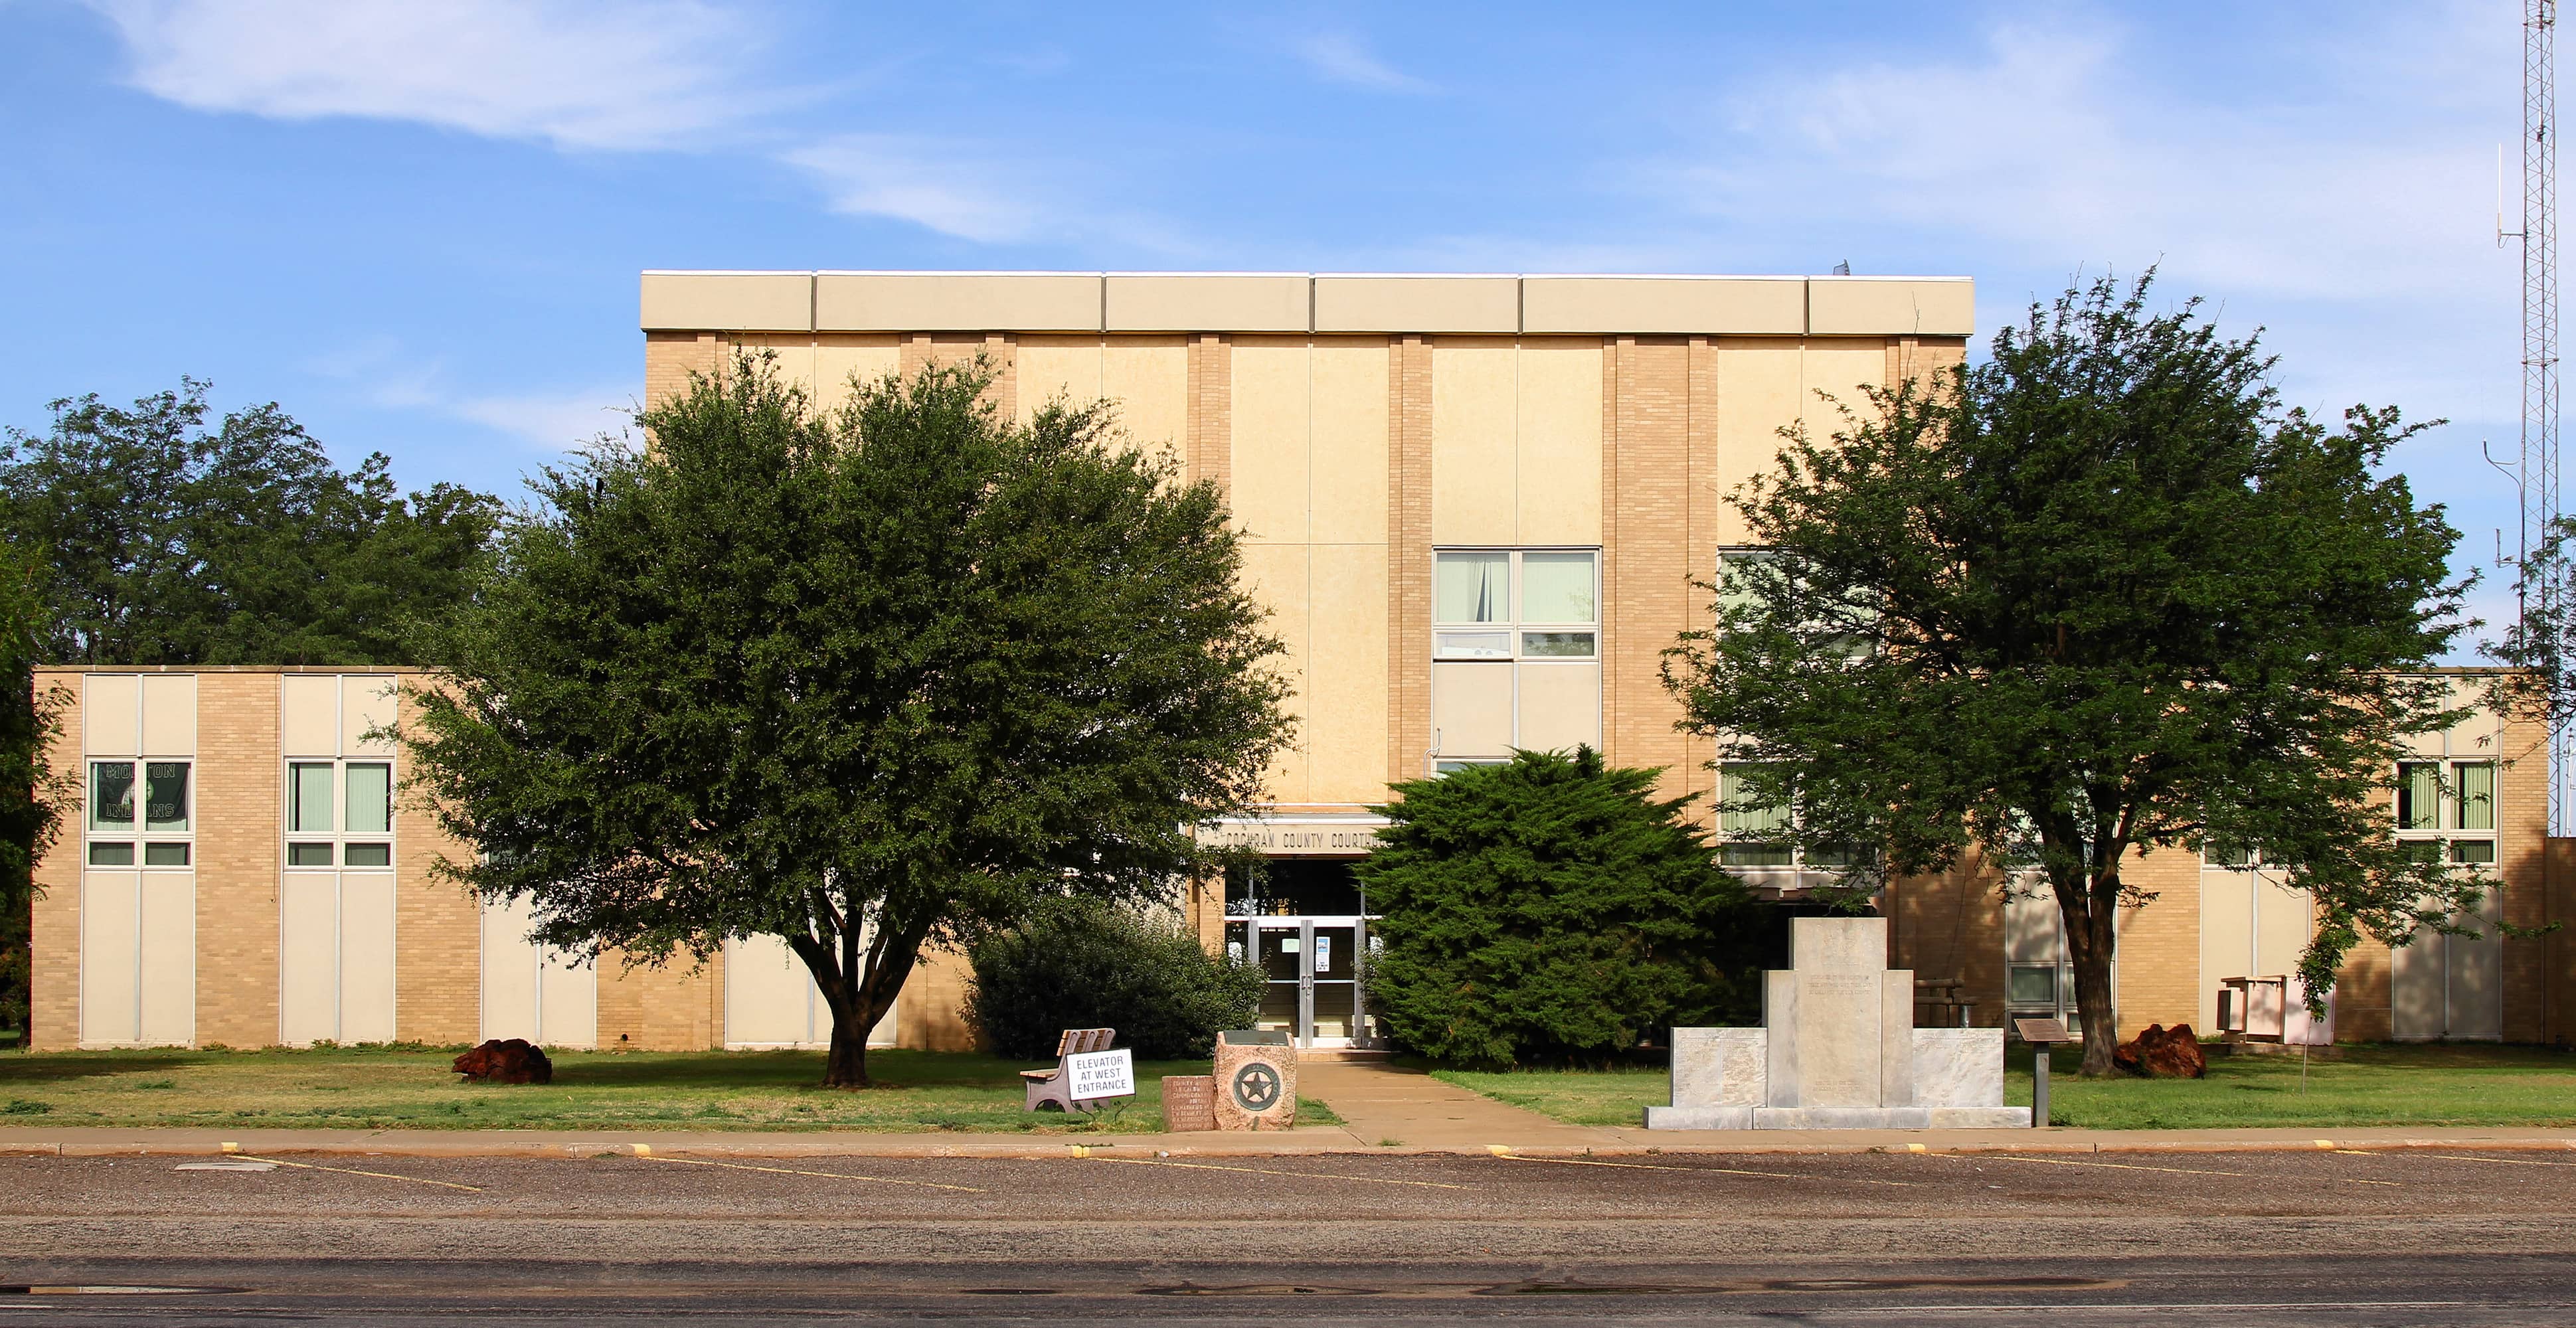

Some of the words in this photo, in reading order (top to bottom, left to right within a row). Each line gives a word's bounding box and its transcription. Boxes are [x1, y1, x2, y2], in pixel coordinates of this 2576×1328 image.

[1283, 833, 1323, 848] COUNTY
[1076, 1056, 1124, 1070] ELEVATOR
[1081, 1071, 1091, 1081] AT
[1095, 1068, 1120, 1079] WEST
[1077, 1079, 1126, 1094] ENTRANCE
